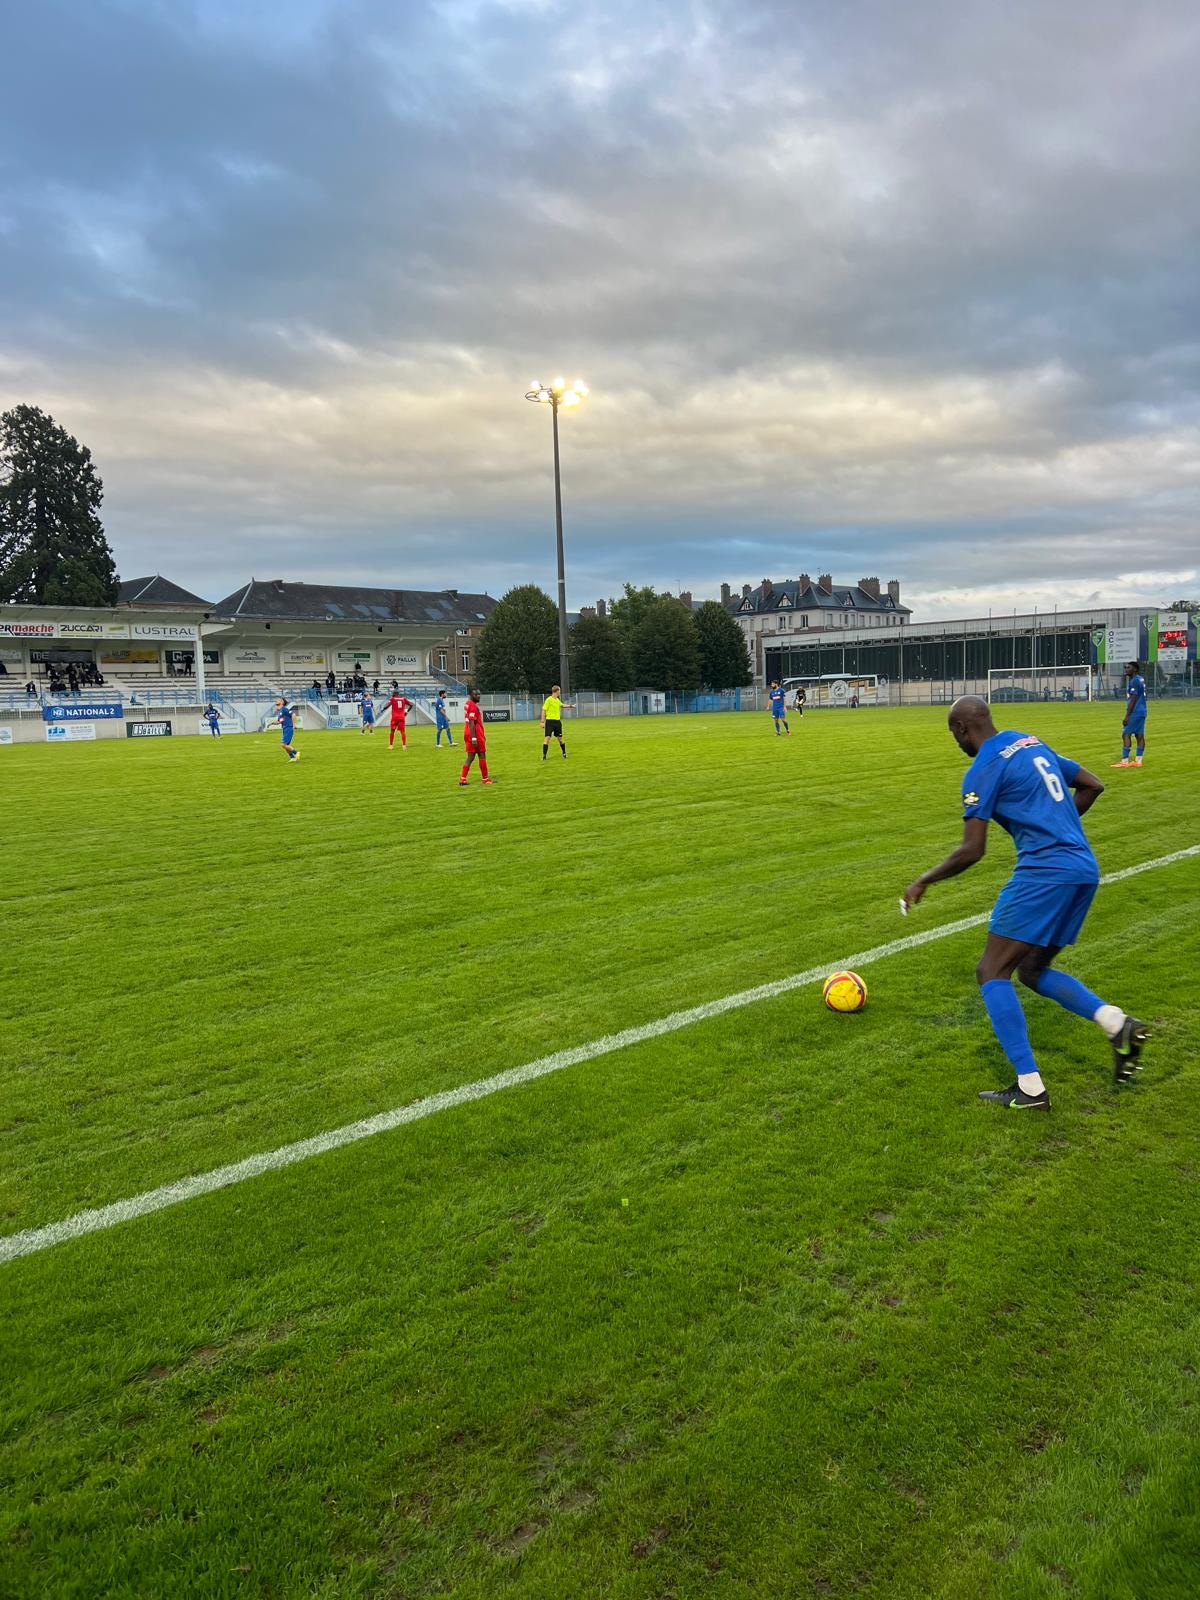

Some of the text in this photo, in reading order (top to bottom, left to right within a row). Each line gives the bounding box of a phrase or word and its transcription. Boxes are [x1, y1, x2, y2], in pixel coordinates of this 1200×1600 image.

[60, 624, 103, 633] ZUCCARI
[134, 626, 197, 635] LUSTRAL
[66, 708, 109, 717] NATIONAL
[110, 707, 115, 715] 2
[1033, 756, 1065, 802] 6
